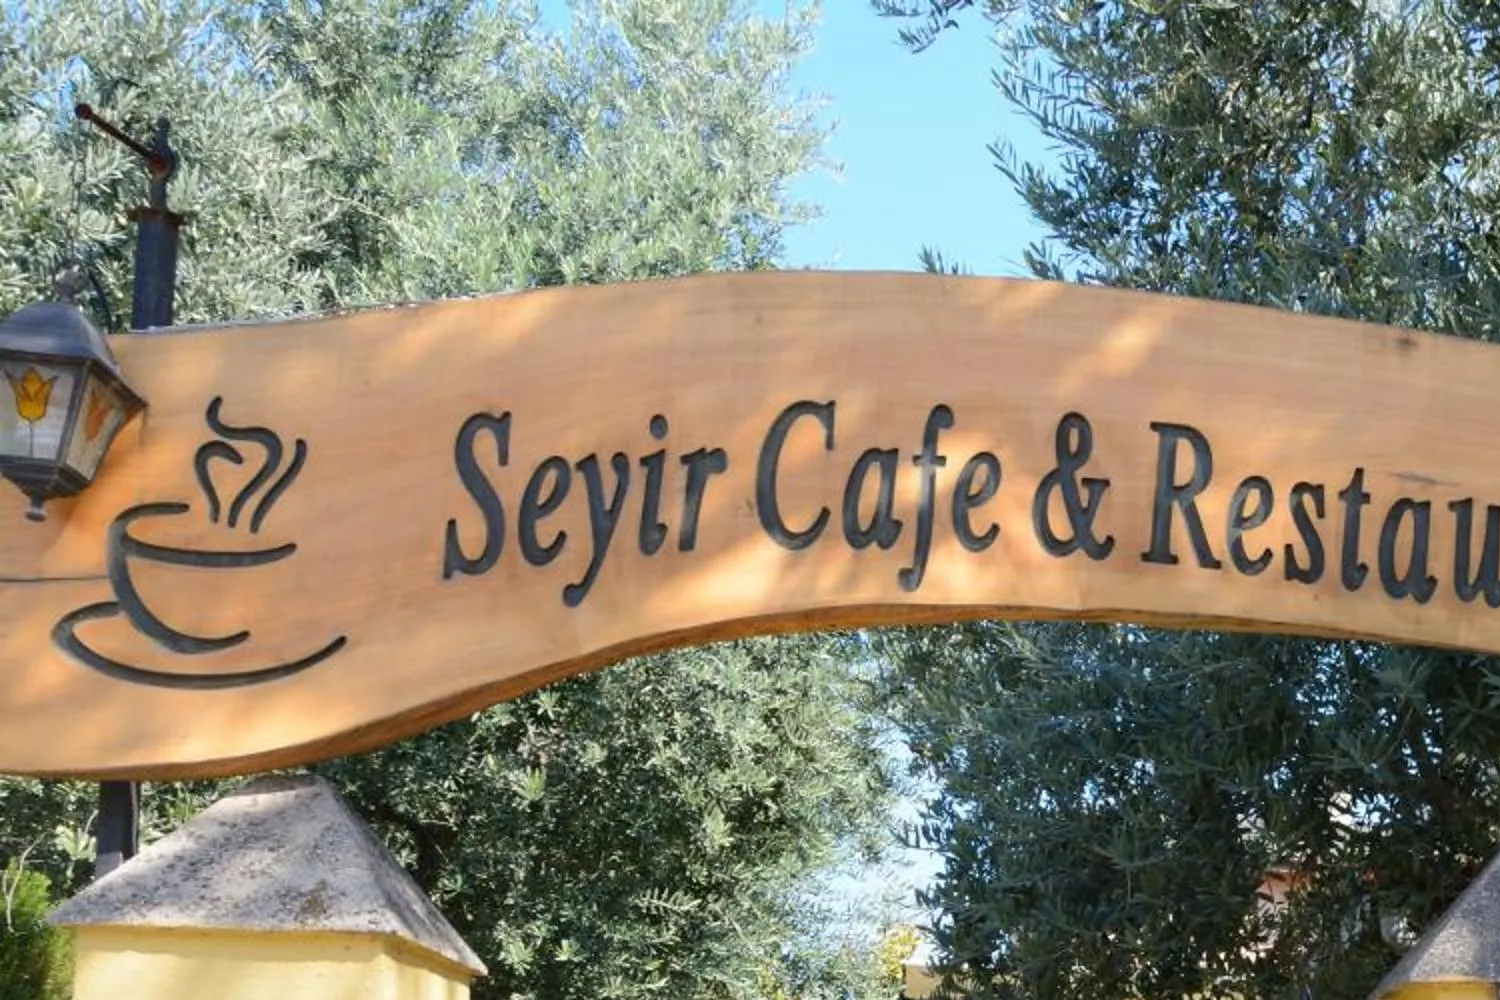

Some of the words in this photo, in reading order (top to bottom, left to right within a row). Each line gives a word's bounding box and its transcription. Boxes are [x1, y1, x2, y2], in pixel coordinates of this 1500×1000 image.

[442, 410, 728, 607] Seyir
[757, 400, 1002, 592] Cafe
[1033, 412, 1115, 561] &
